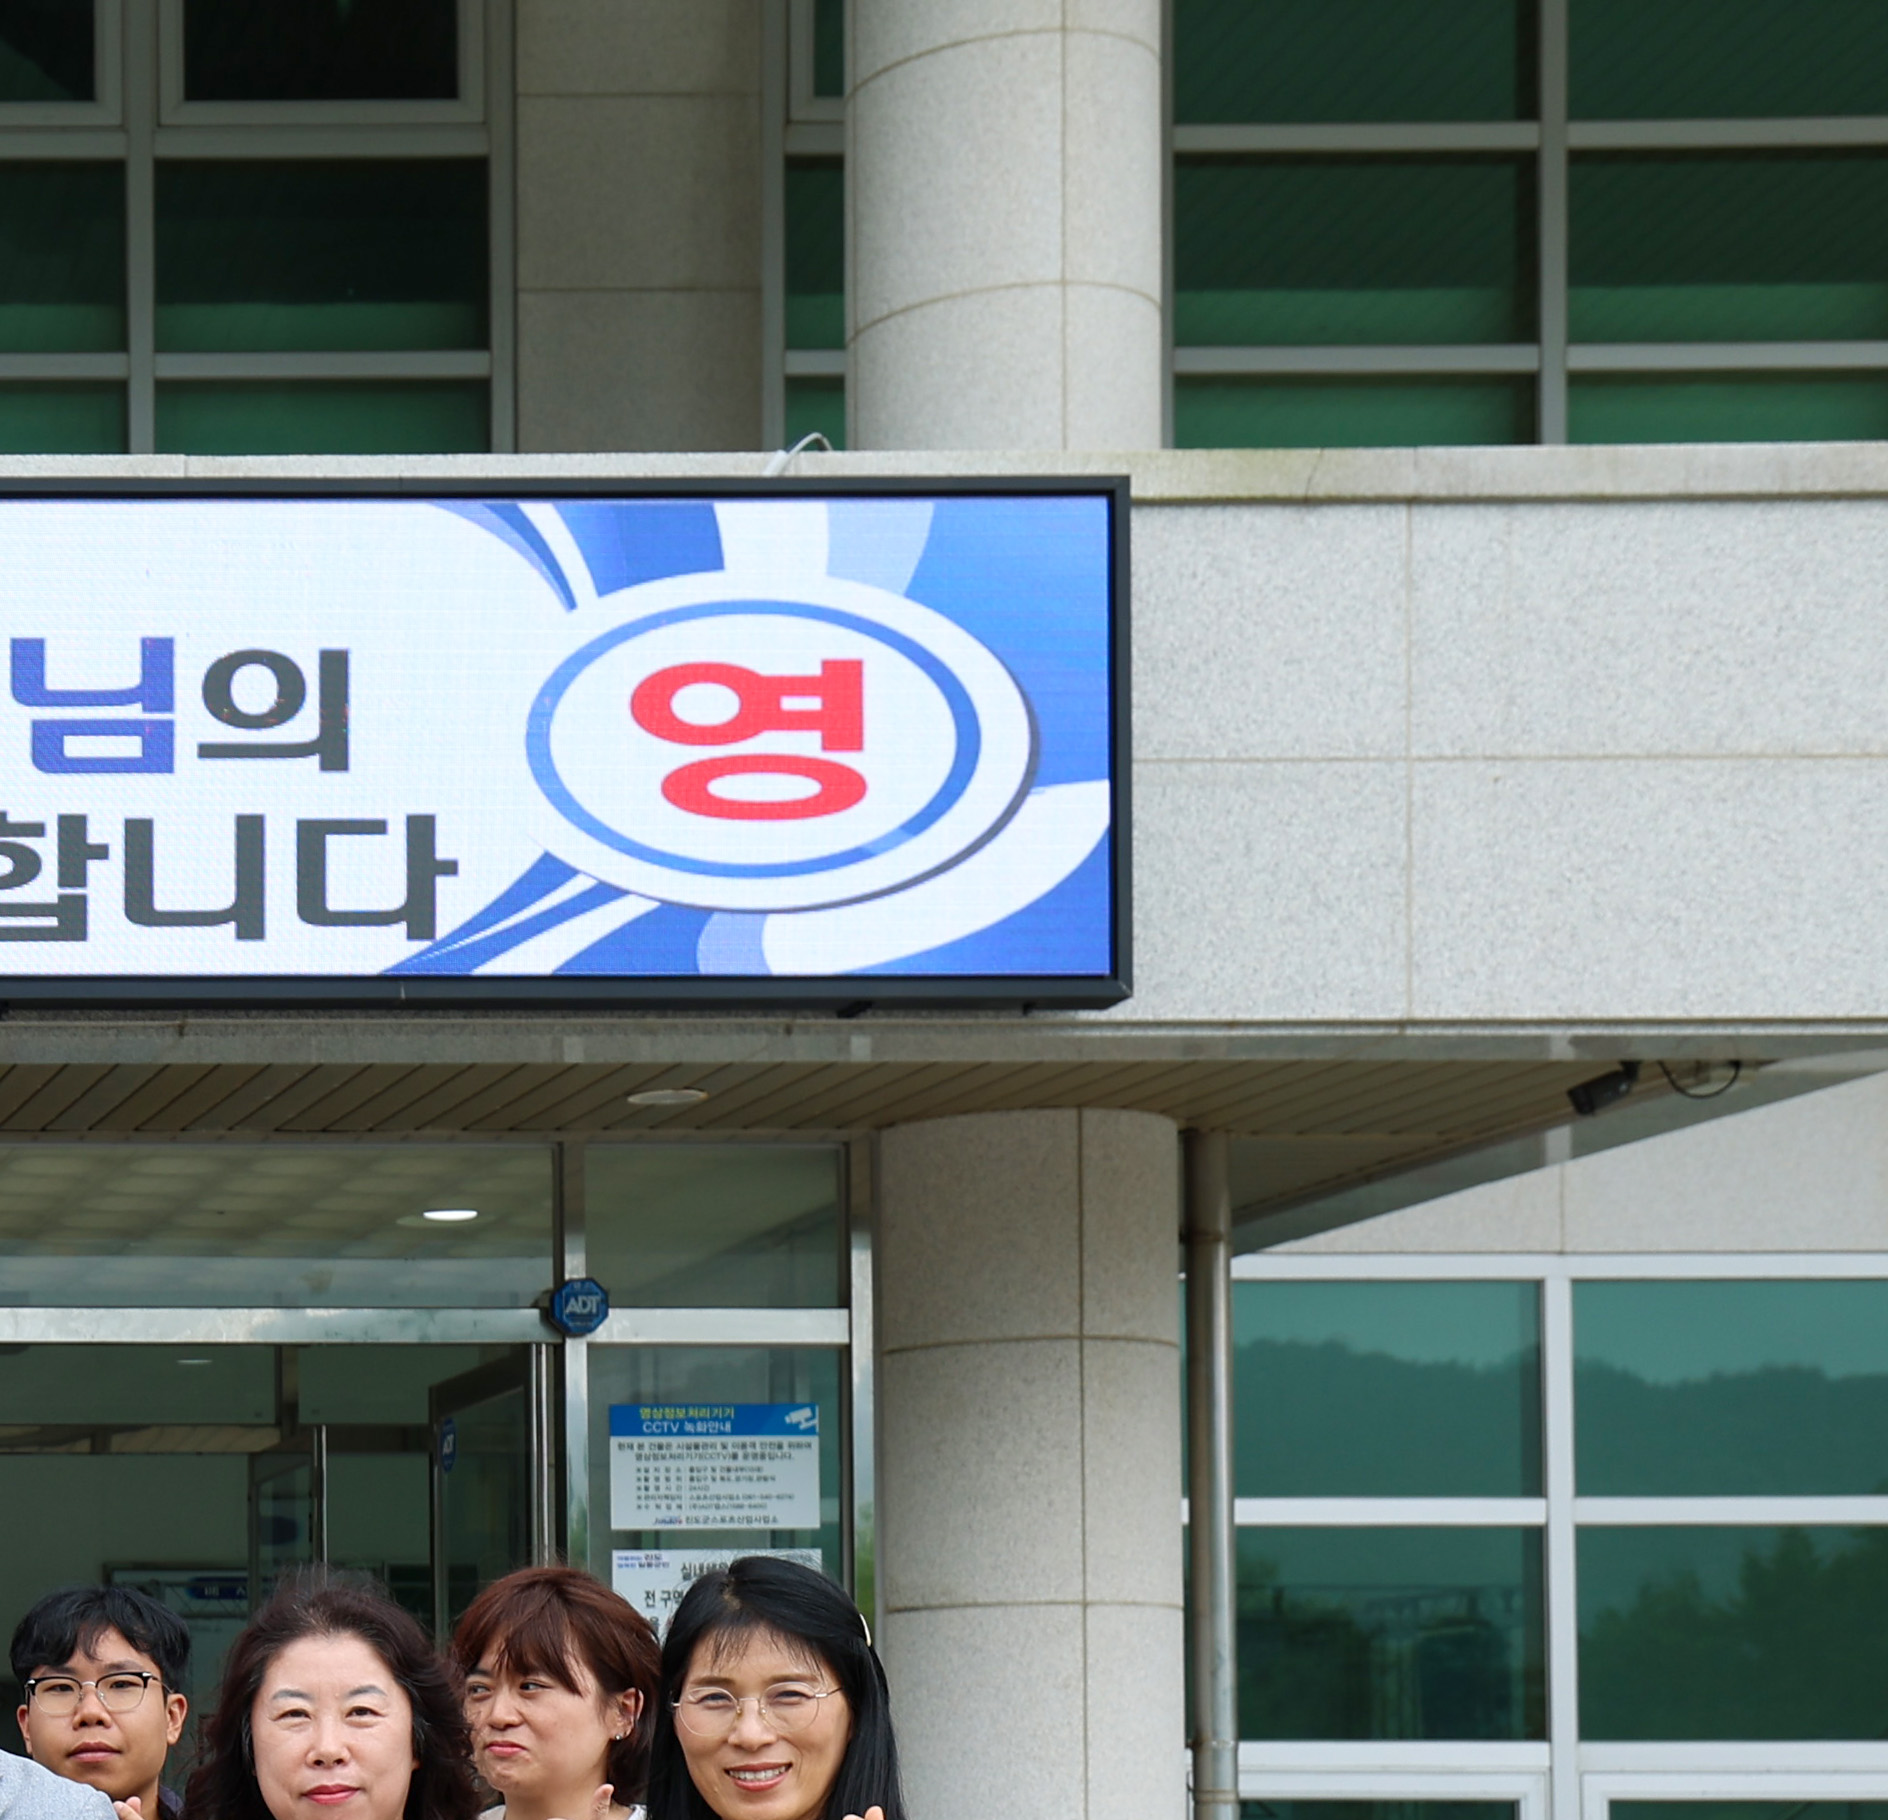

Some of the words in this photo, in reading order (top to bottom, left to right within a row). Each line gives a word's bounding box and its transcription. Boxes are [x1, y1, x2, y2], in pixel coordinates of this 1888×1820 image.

[630, 656, 867, 823] 영
[565, 1296, 601, 1314] ADT
[642, 1421, 680, 1433] CCTV
[683, 1421, 732, 1433] 녹화안내
